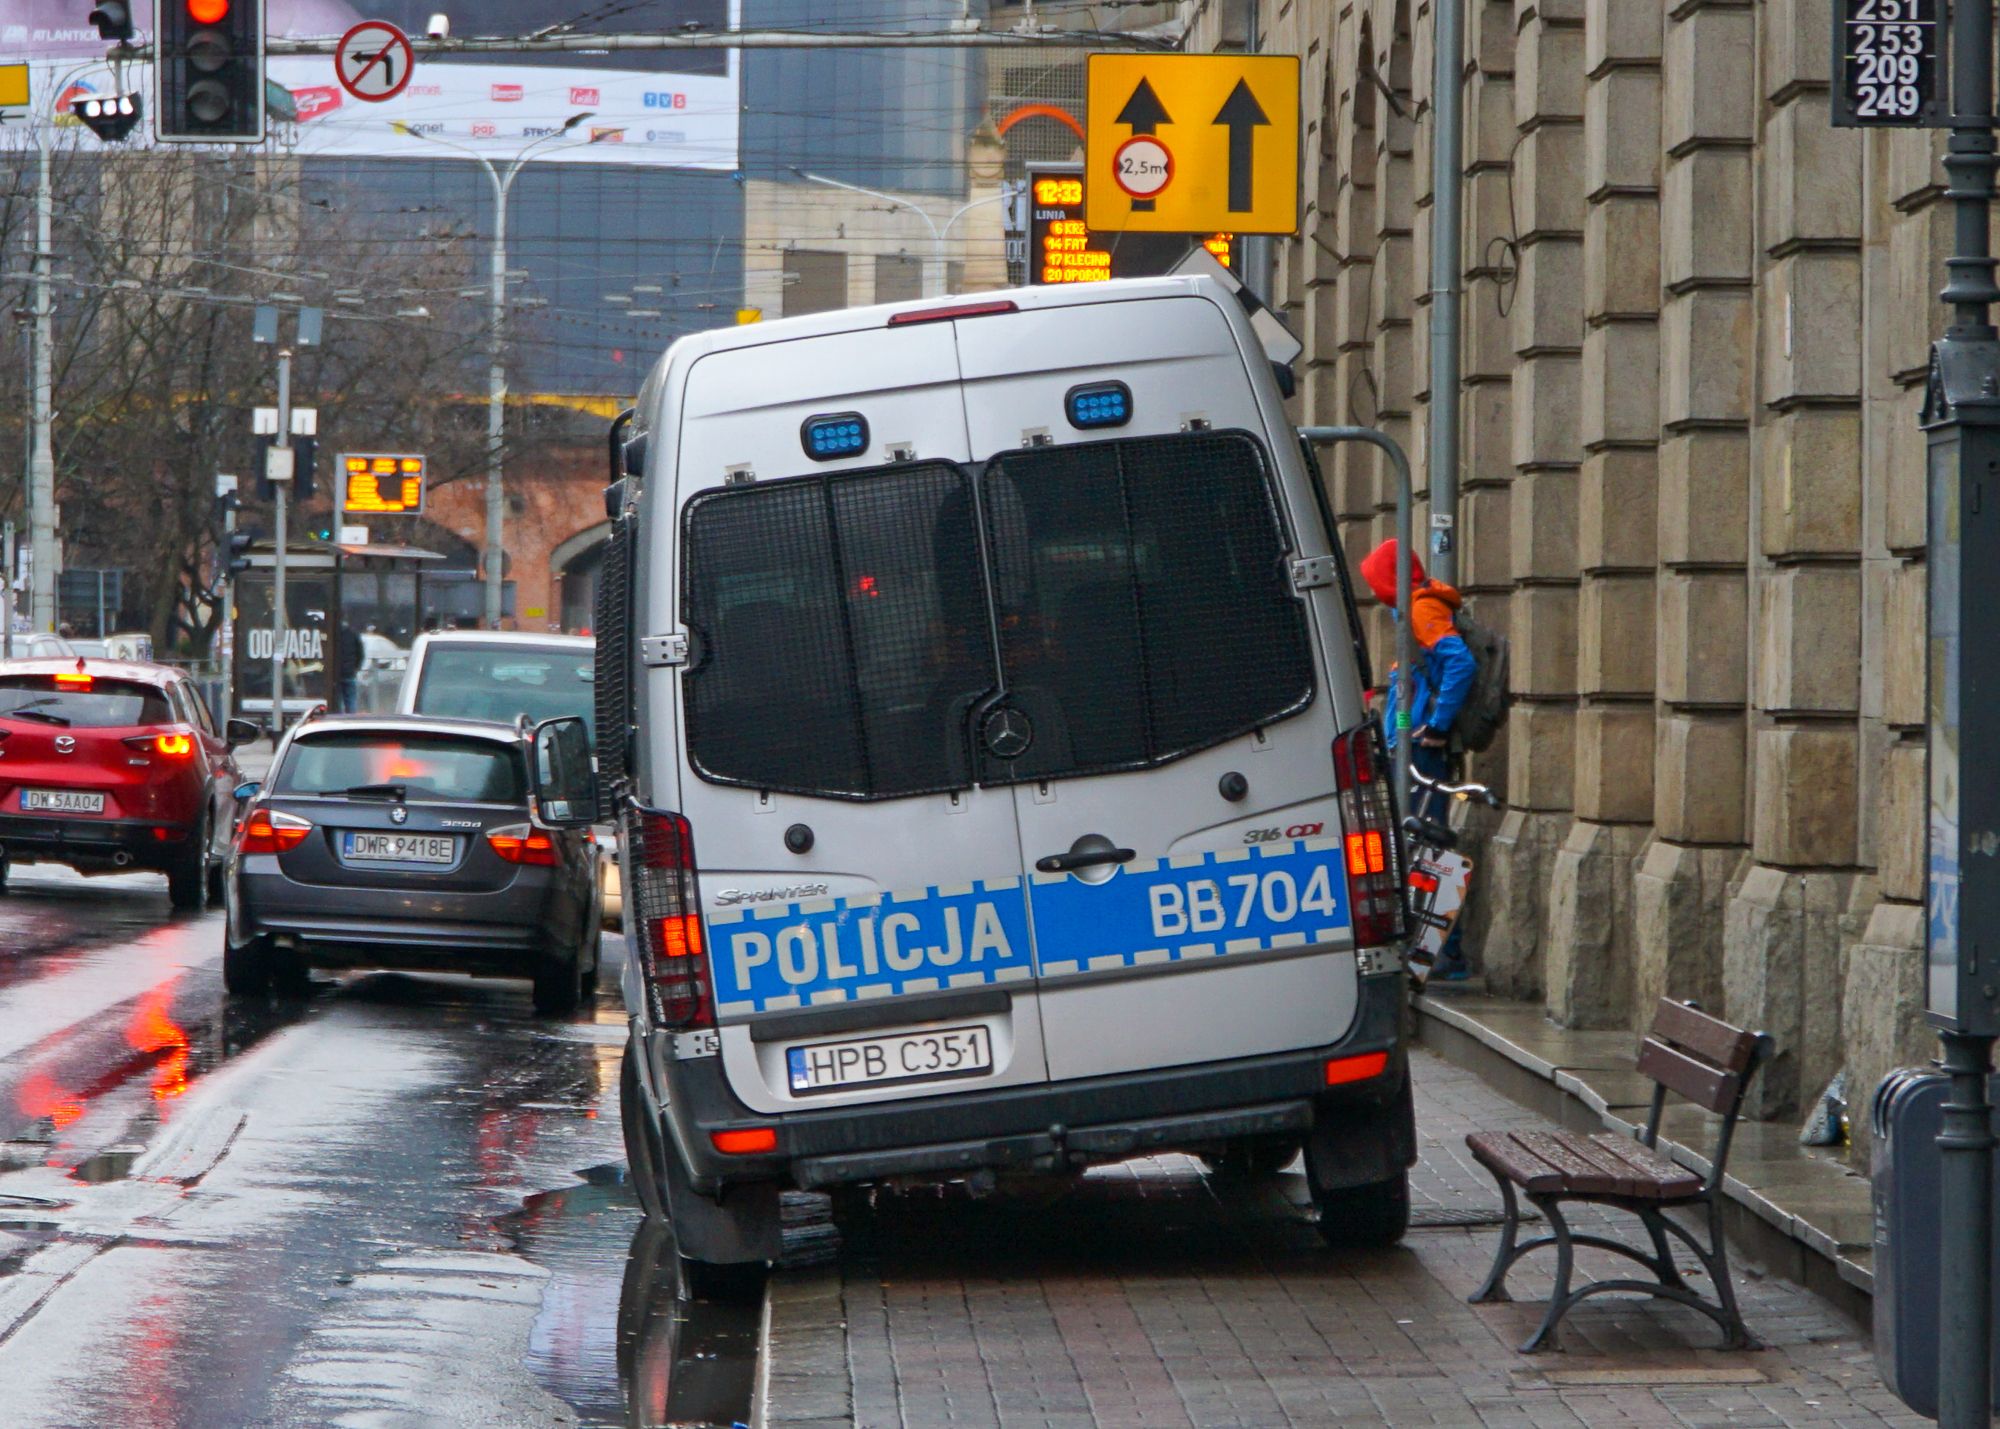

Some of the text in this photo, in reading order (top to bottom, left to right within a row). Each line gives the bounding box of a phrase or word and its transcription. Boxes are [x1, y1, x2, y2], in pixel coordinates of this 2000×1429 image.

[1856, 0, 1919, 20] 251
[1855, 25, 1923, 54] 253
[1857, 54, 1919, 85] 209
[1857, 85, 1919, 116] 249
[1038, 182, 1082, 204] 12:33
[1036, 211, 1066, 220] LINIA
[1054, 222, 1086, 235] 6 KRZ
[1047, 237, 1062, 250] 14
[1049, 253, 1062, 266] 17
[1064, 253, 1110, 266] KLECINA
[1047, 268, 1062, 281] 20
[30, 792, 101, 810] DW 5AA04
[1243, 822, 1324, 844] 316 CDI
[355, 836, 389, 855] DWR
[395, 837, 451, 858] 9418E
[731, 865, 1337, 991] POLICJA BB704
[810, 1034, 982, 1084] HPB C351
